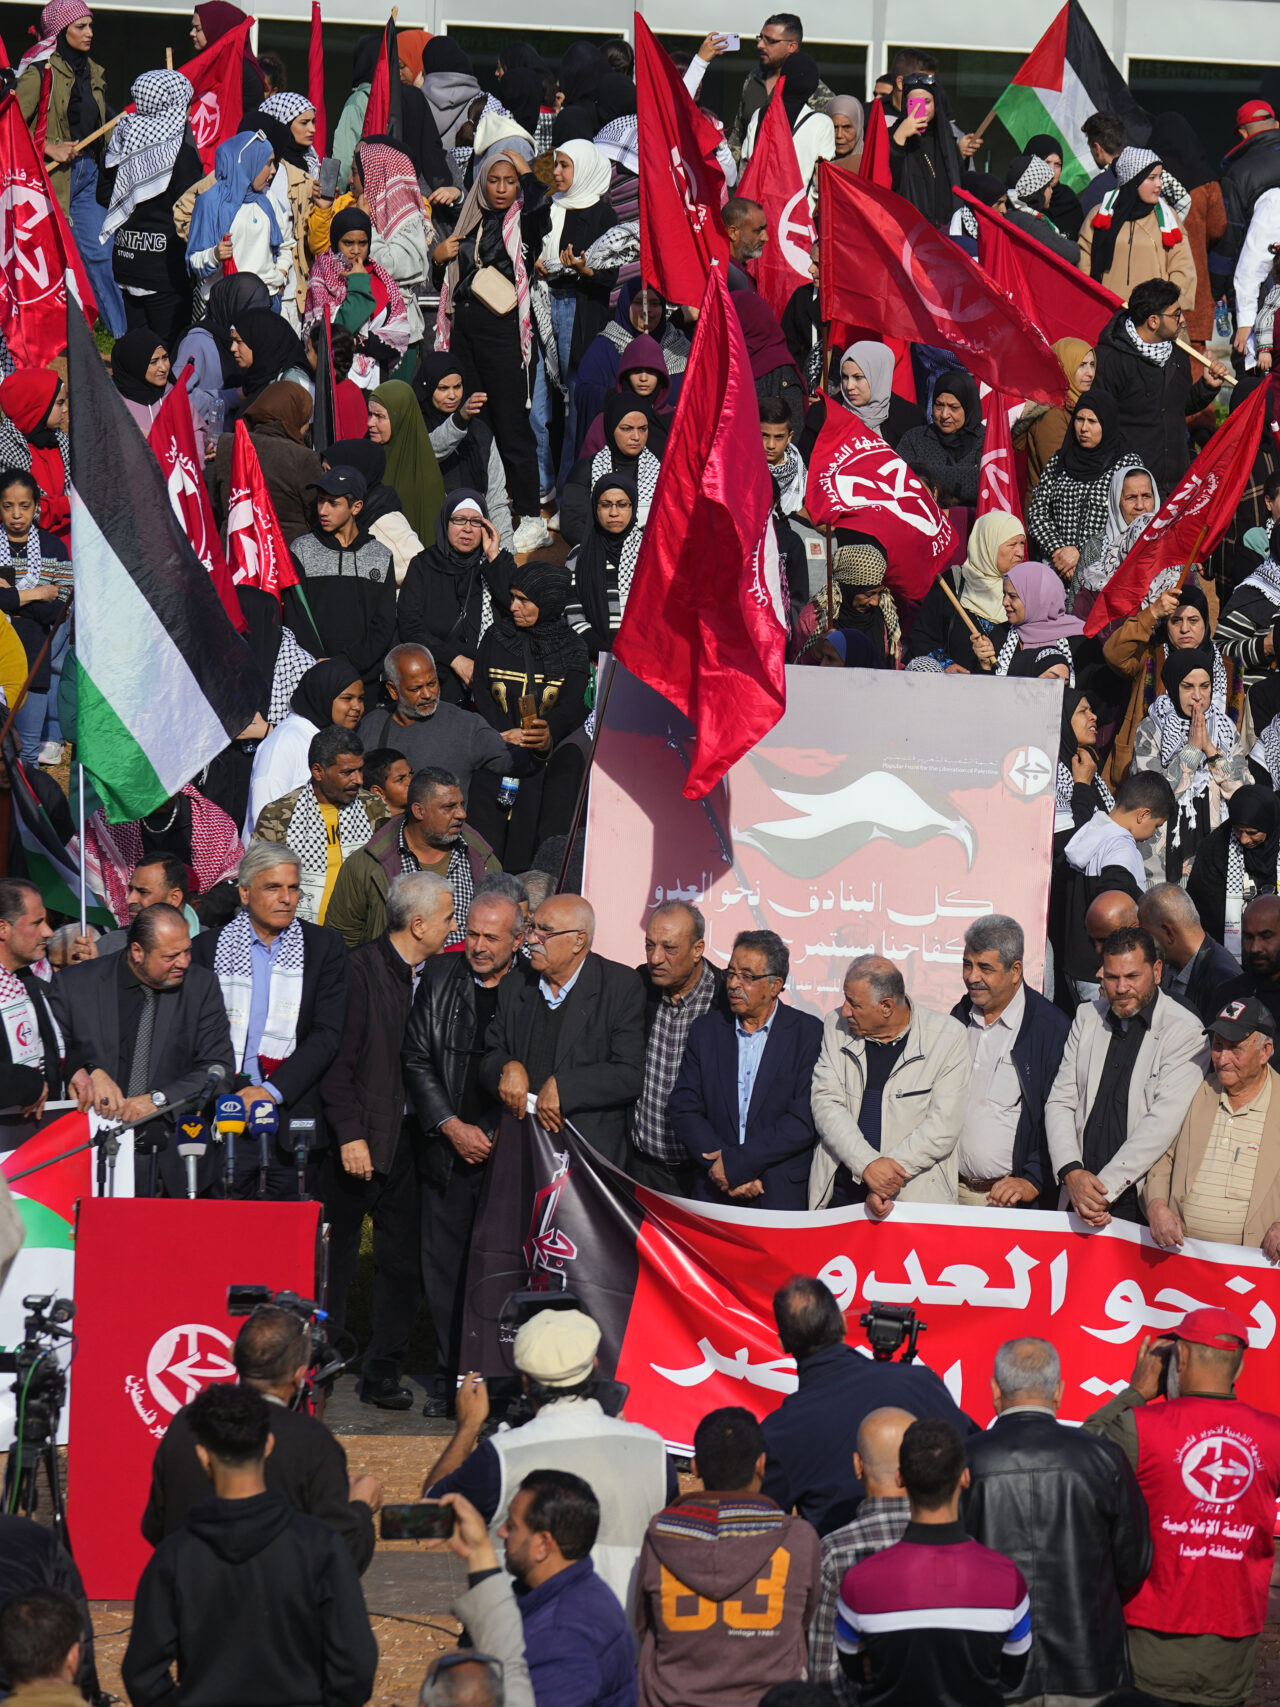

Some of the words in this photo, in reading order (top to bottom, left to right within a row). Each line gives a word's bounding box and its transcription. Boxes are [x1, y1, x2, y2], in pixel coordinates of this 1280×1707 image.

[117, 249, 135, 260] STUDIO
[648, 871, 713, 908] العدو
[713, 880, 761, 912] نحو
[767, 880, 883, 918] البنادق
[887, 885, 994, 926] كل
[793, 932, 876, 965] مستمر
[881, 930, 965, 965] كفاحنا
[815, 1245, 1068, 1316] العدو
[124, 1374, 158, 1427] فلسطين
[1179, 1542, 1207, 1560] صيدا
[1208, 1543, 1244, 1561] منطقة
